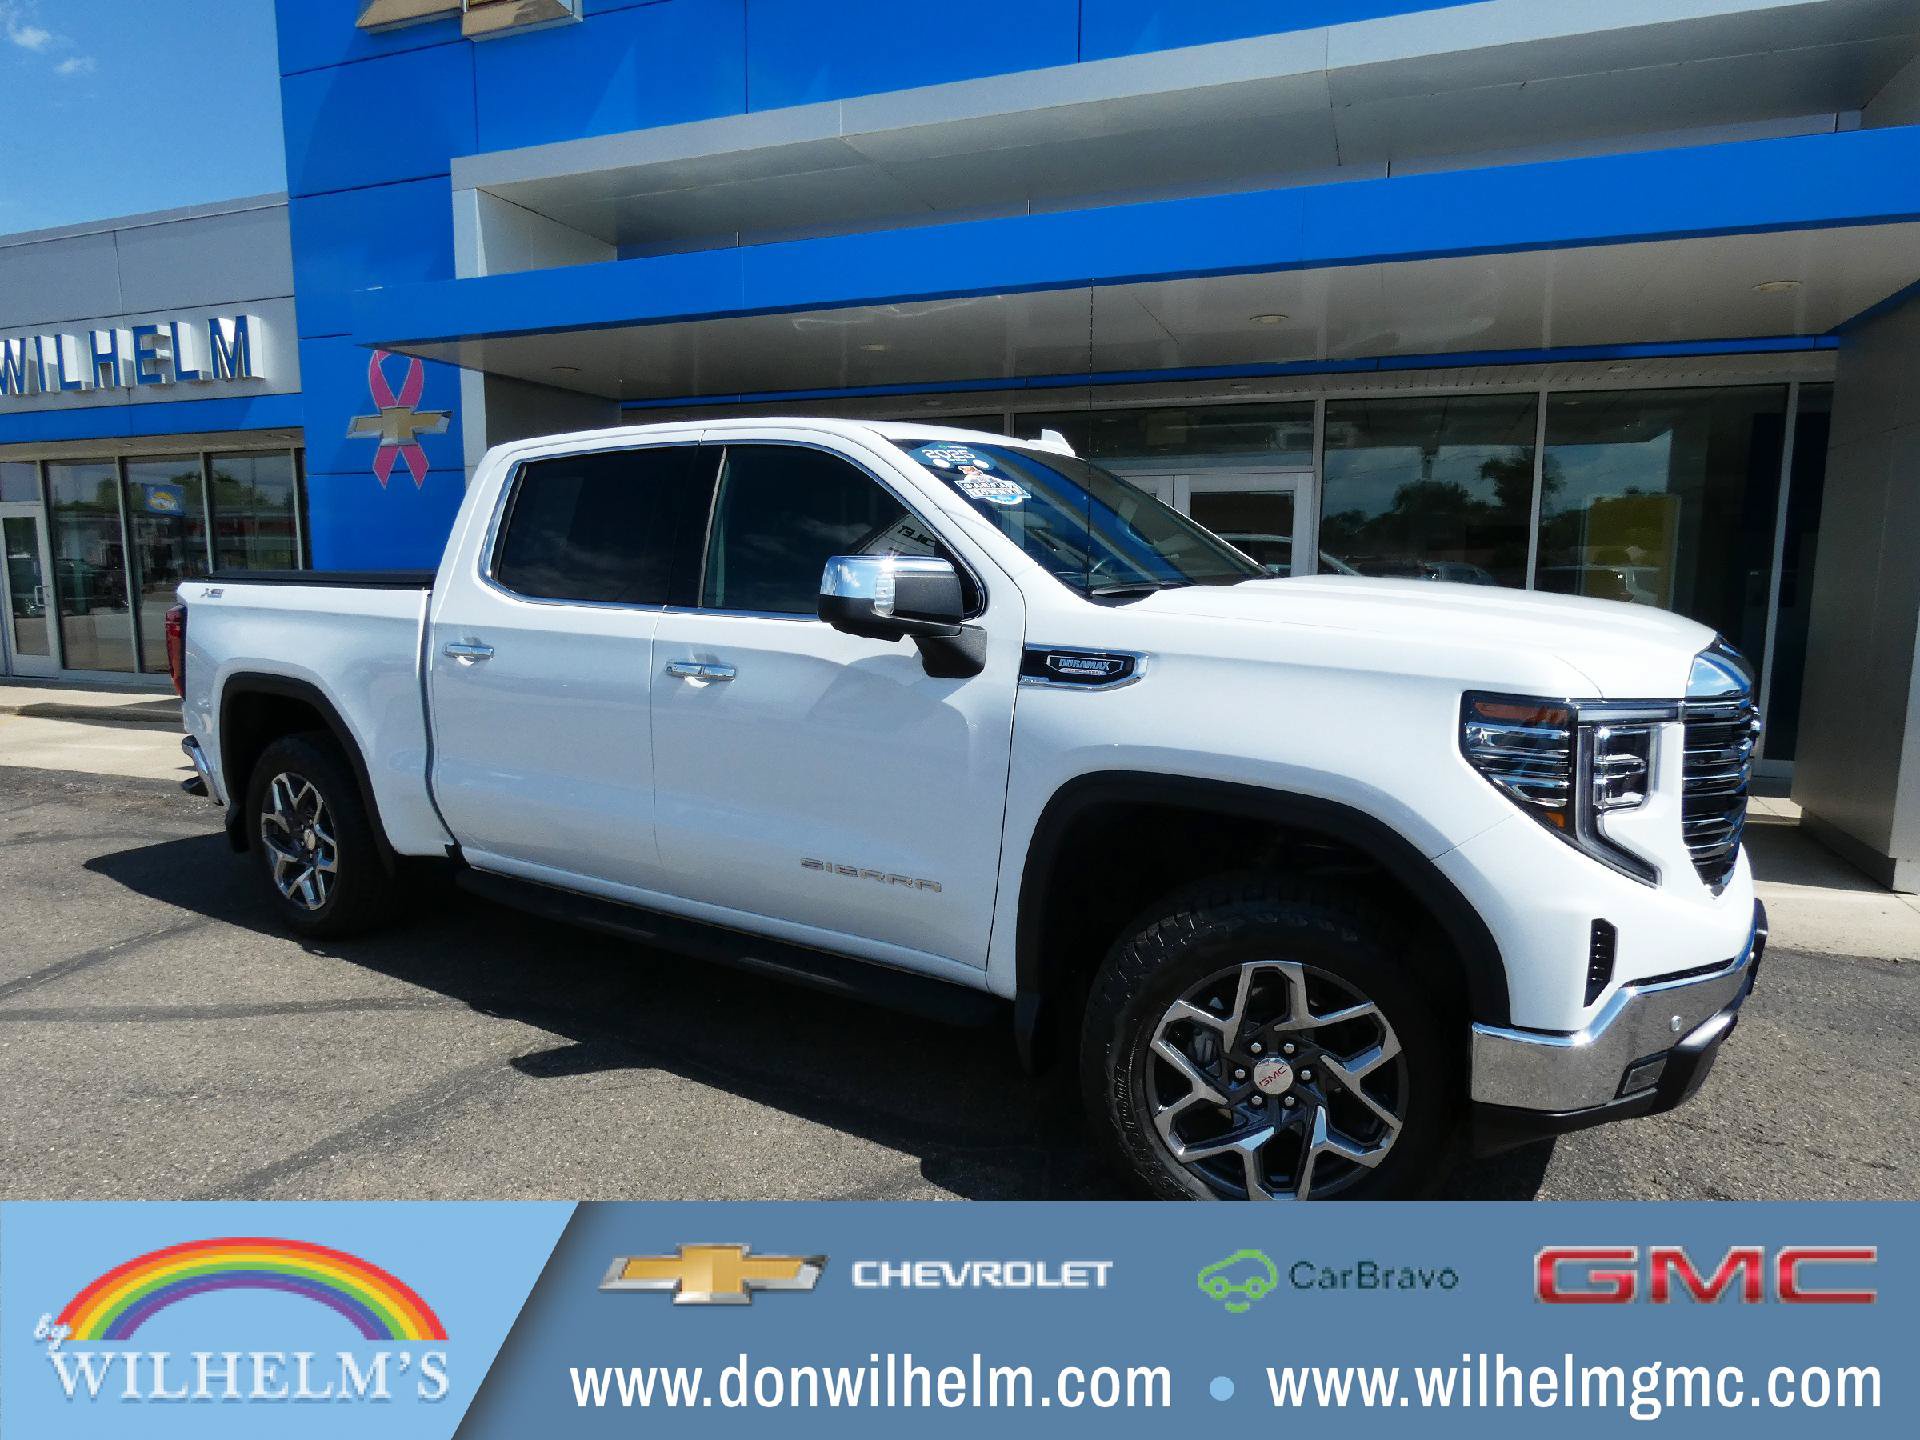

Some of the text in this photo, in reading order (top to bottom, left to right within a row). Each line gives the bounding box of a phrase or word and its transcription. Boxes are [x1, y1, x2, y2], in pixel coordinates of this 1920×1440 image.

[0, 315, 254, 395] WILHELM
[1058, 658, 1110, 671] DURAMAX
[800, 857, 943, 893] SIERRA
[1258, 1065, 1288, 1088] GMC
